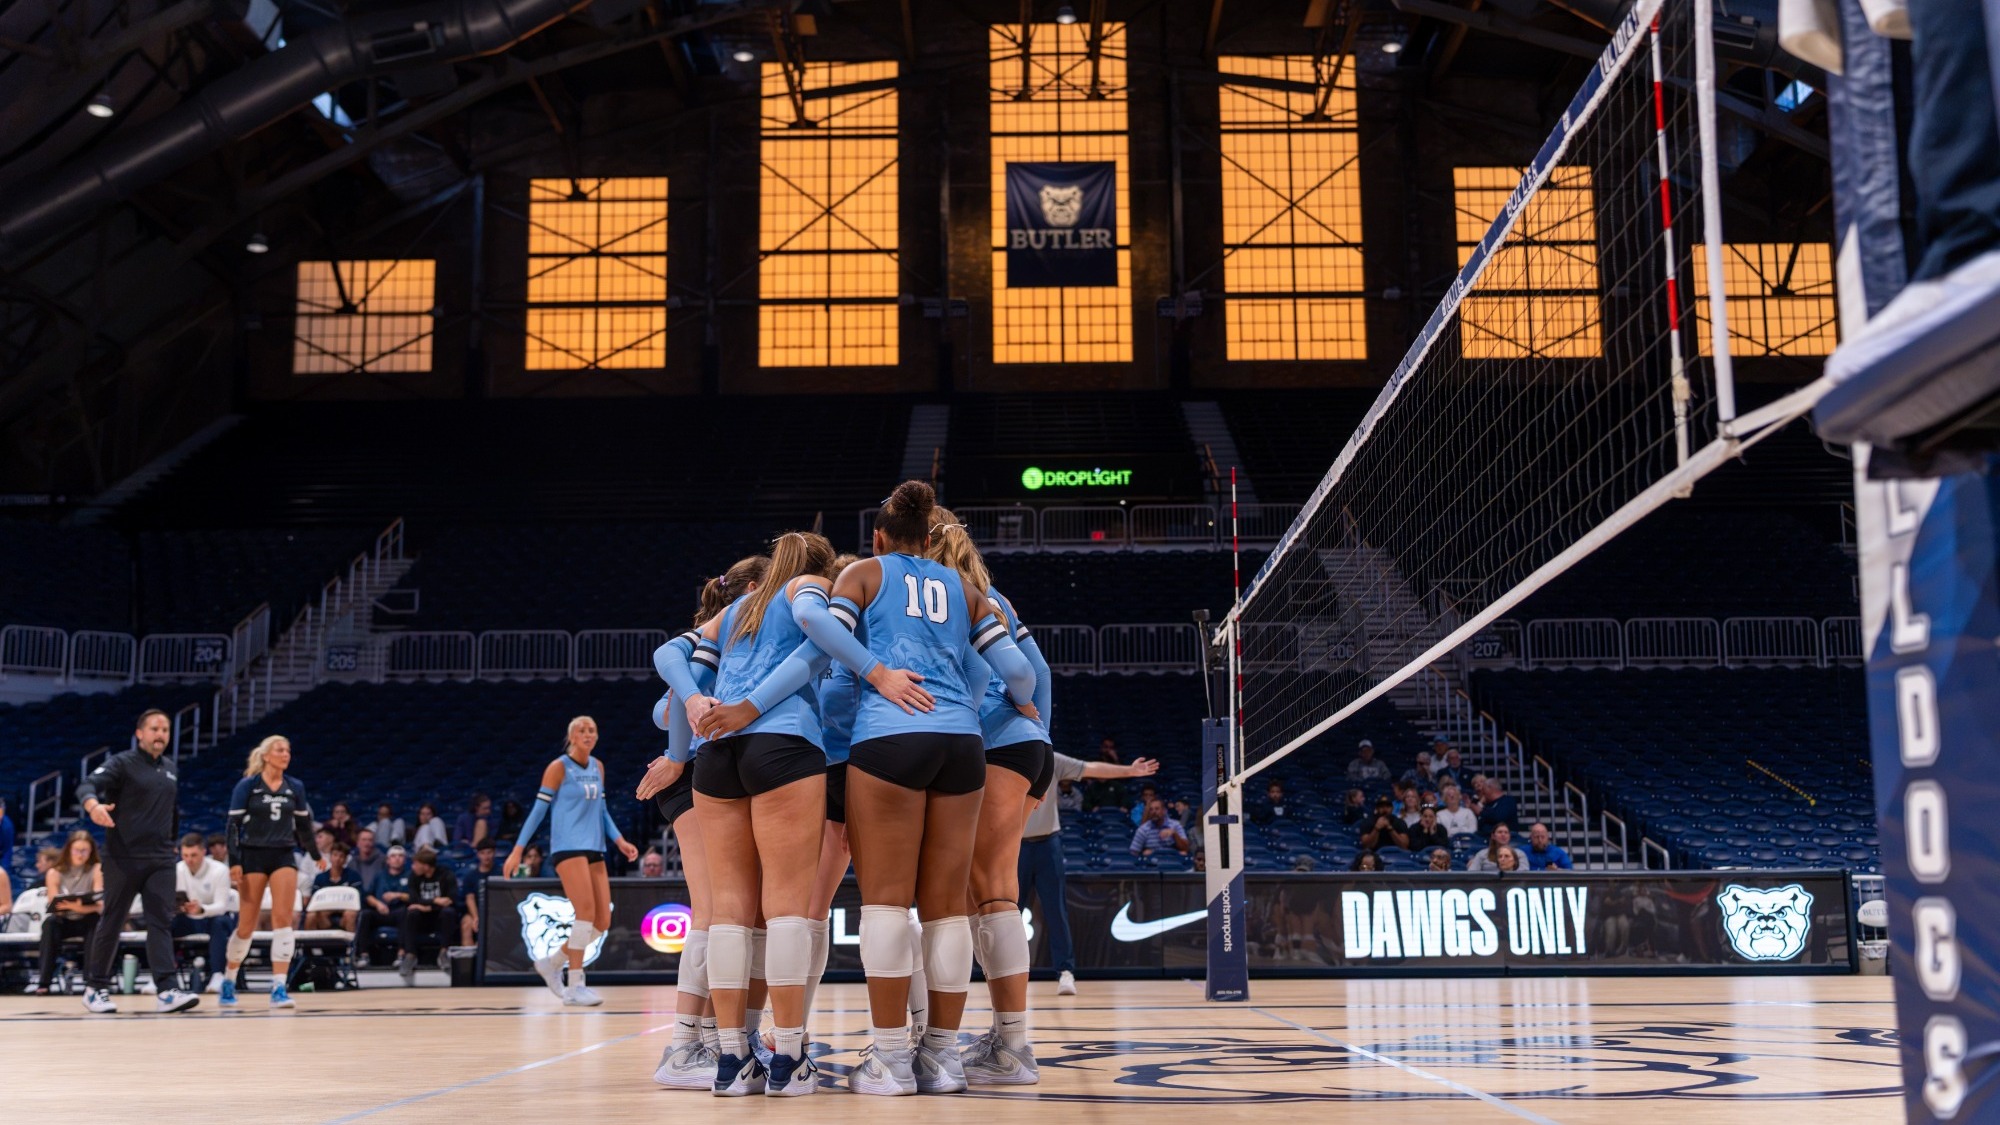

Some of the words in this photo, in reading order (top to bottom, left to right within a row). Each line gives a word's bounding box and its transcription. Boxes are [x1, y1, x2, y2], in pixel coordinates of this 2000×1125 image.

[1010, 228, 1112, 250] BUTLER
[904, 573, 949, 624] 10
[194, 646, 223, 662] 204
[1474, 642, 1500, 657] 207
[328, 654, 356, 670] 205
[584, 783, 598, 800] 17
[270, 802, 281, 820] 5
[1221, 883, 1231, 914] sports
[1341, 888, 1499, 958] DAWGS
[1506, 886, 1588, 956] ONLY
[1222, 914, 1233, 952] imports
